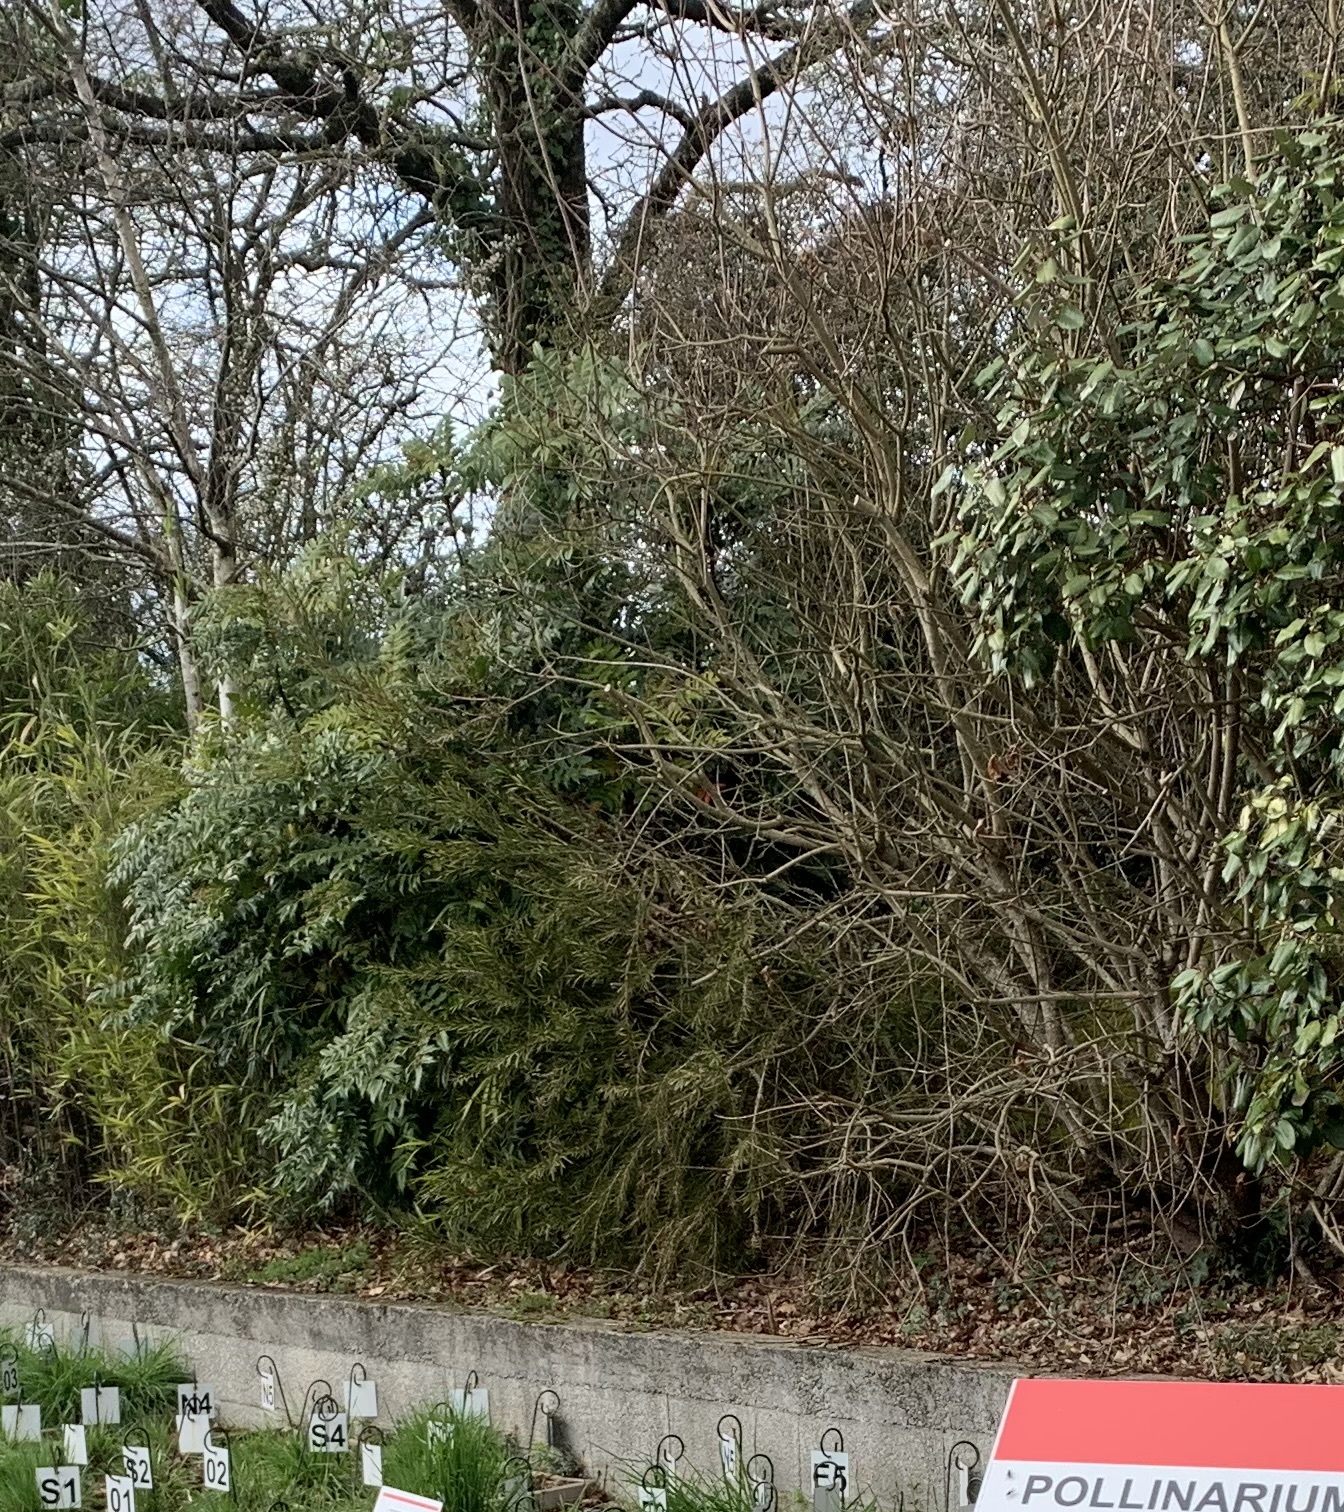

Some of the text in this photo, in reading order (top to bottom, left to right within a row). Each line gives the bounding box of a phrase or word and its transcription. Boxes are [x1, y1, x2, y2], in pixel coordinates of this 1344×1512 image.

[3, 1368, 18, 1391] 03
[181, 1392, 212, 1415] N4
[312, 1423, 346, 1448] S4
[207, 1458, 227, 1486] 02
[41, 1478, 76, 1504] S1
